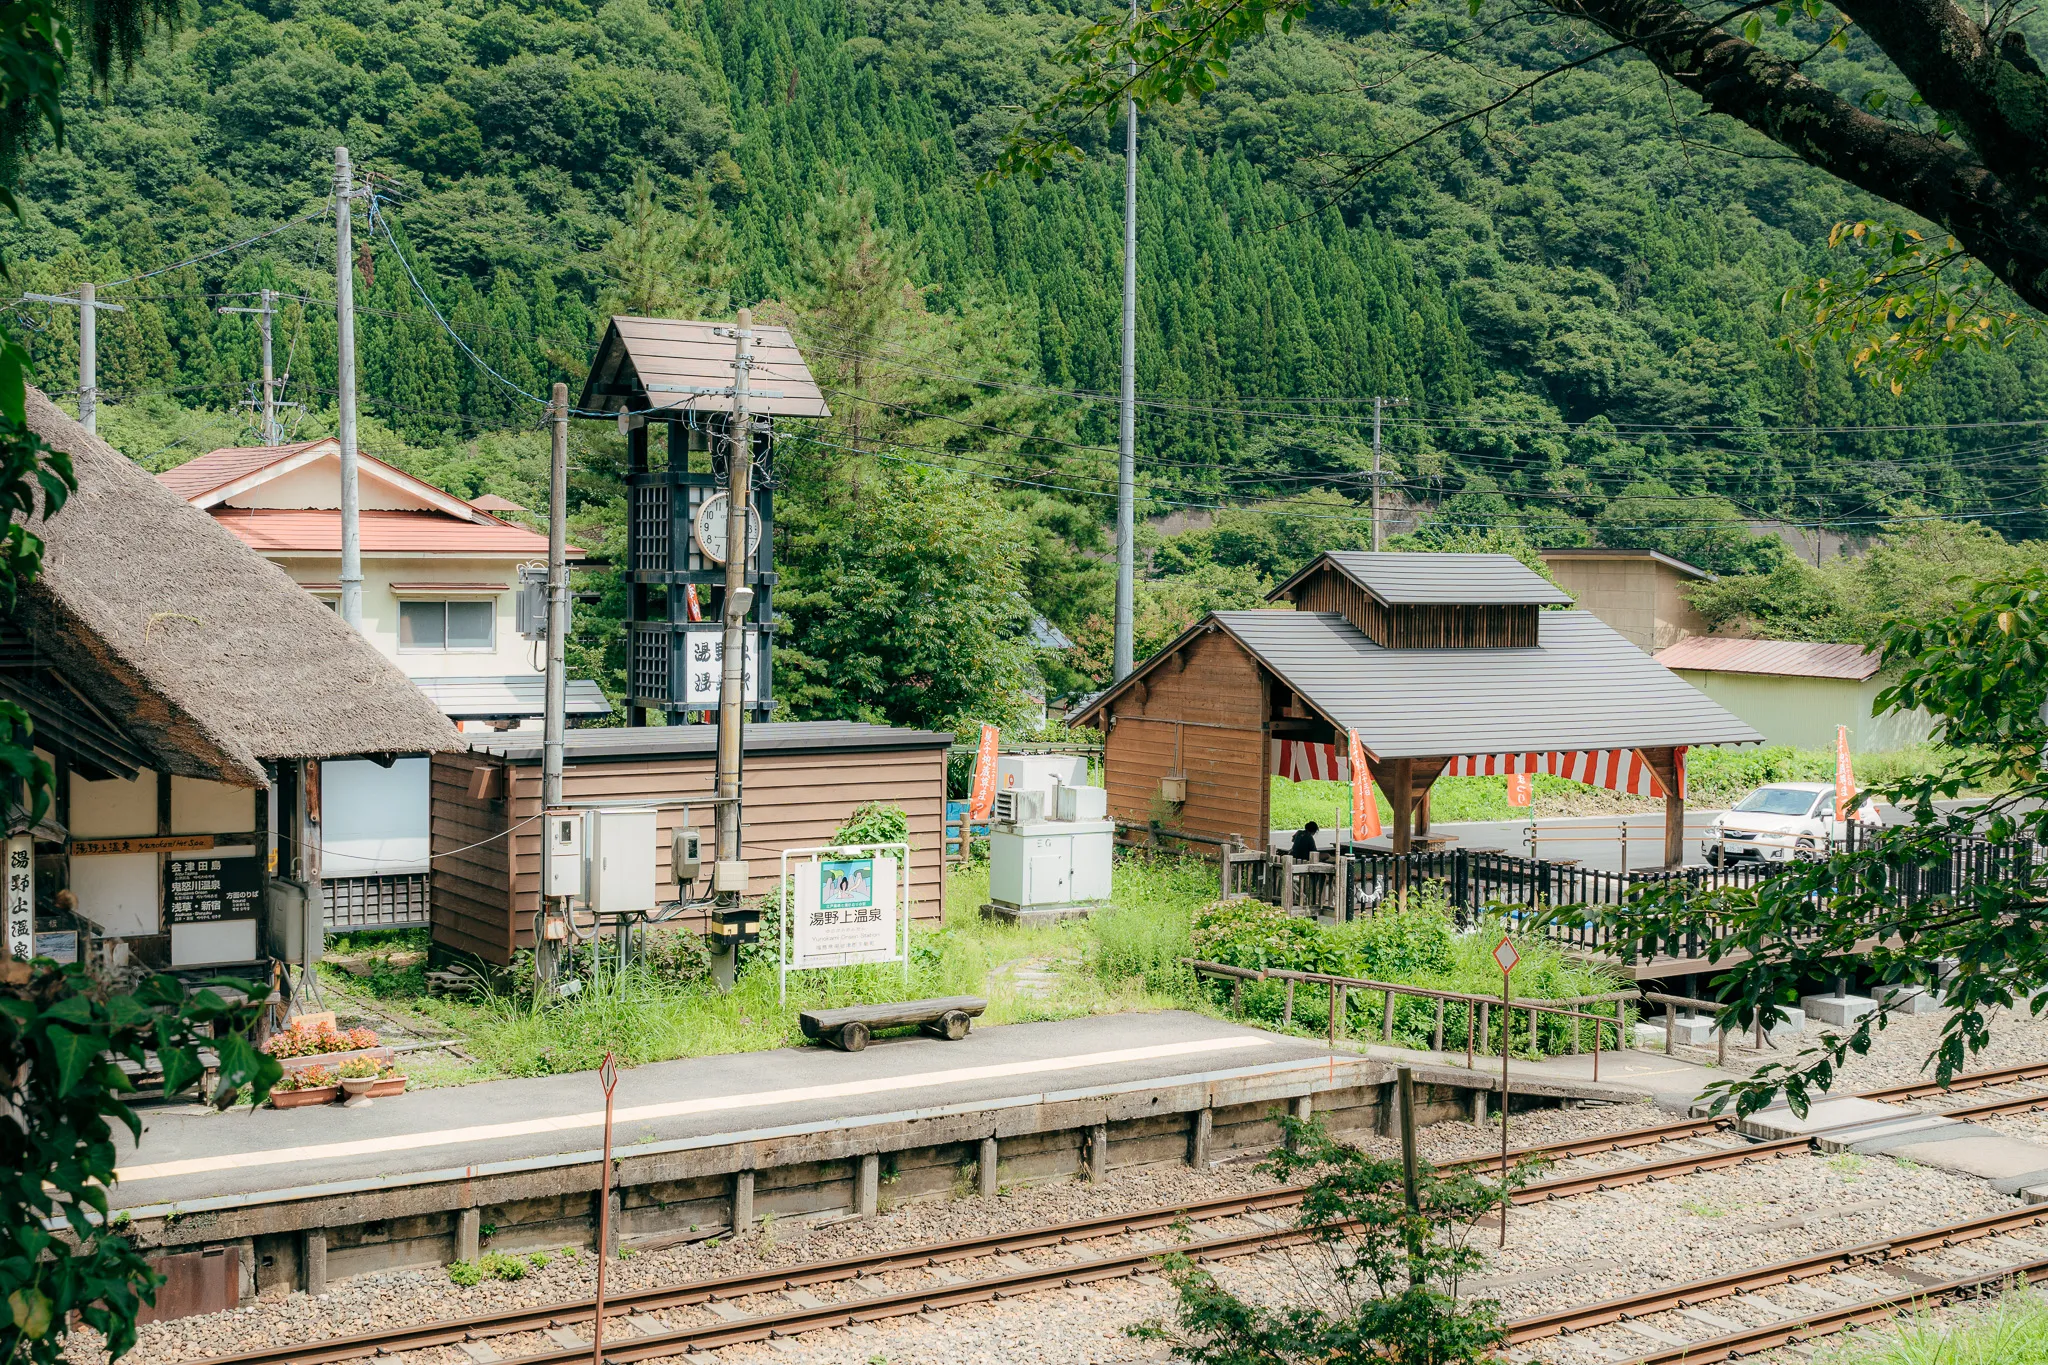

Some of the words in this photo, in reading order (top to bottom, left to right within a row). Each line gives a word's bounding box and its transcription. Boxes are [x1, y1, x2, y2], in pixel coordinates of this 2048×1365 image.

[715, 502, 722, 511] 11
[706, 510, 714, 520] 10
[704, 522, 710, 532] 9
[706, 534, 713, 544] 8
[715, 544, 721, 553] 7
[171, 860, 222, 873] 会津田島
[171, 880, 221, 892] 鬼怒川温泉
[226, 890, 259, 900] 方面のりば
[10, 850, 30, 960] 湯野上温泉
[171, 900, 221, 912] 浅草・新宿
[809, 908, 882, 927] 湯野上温泉
